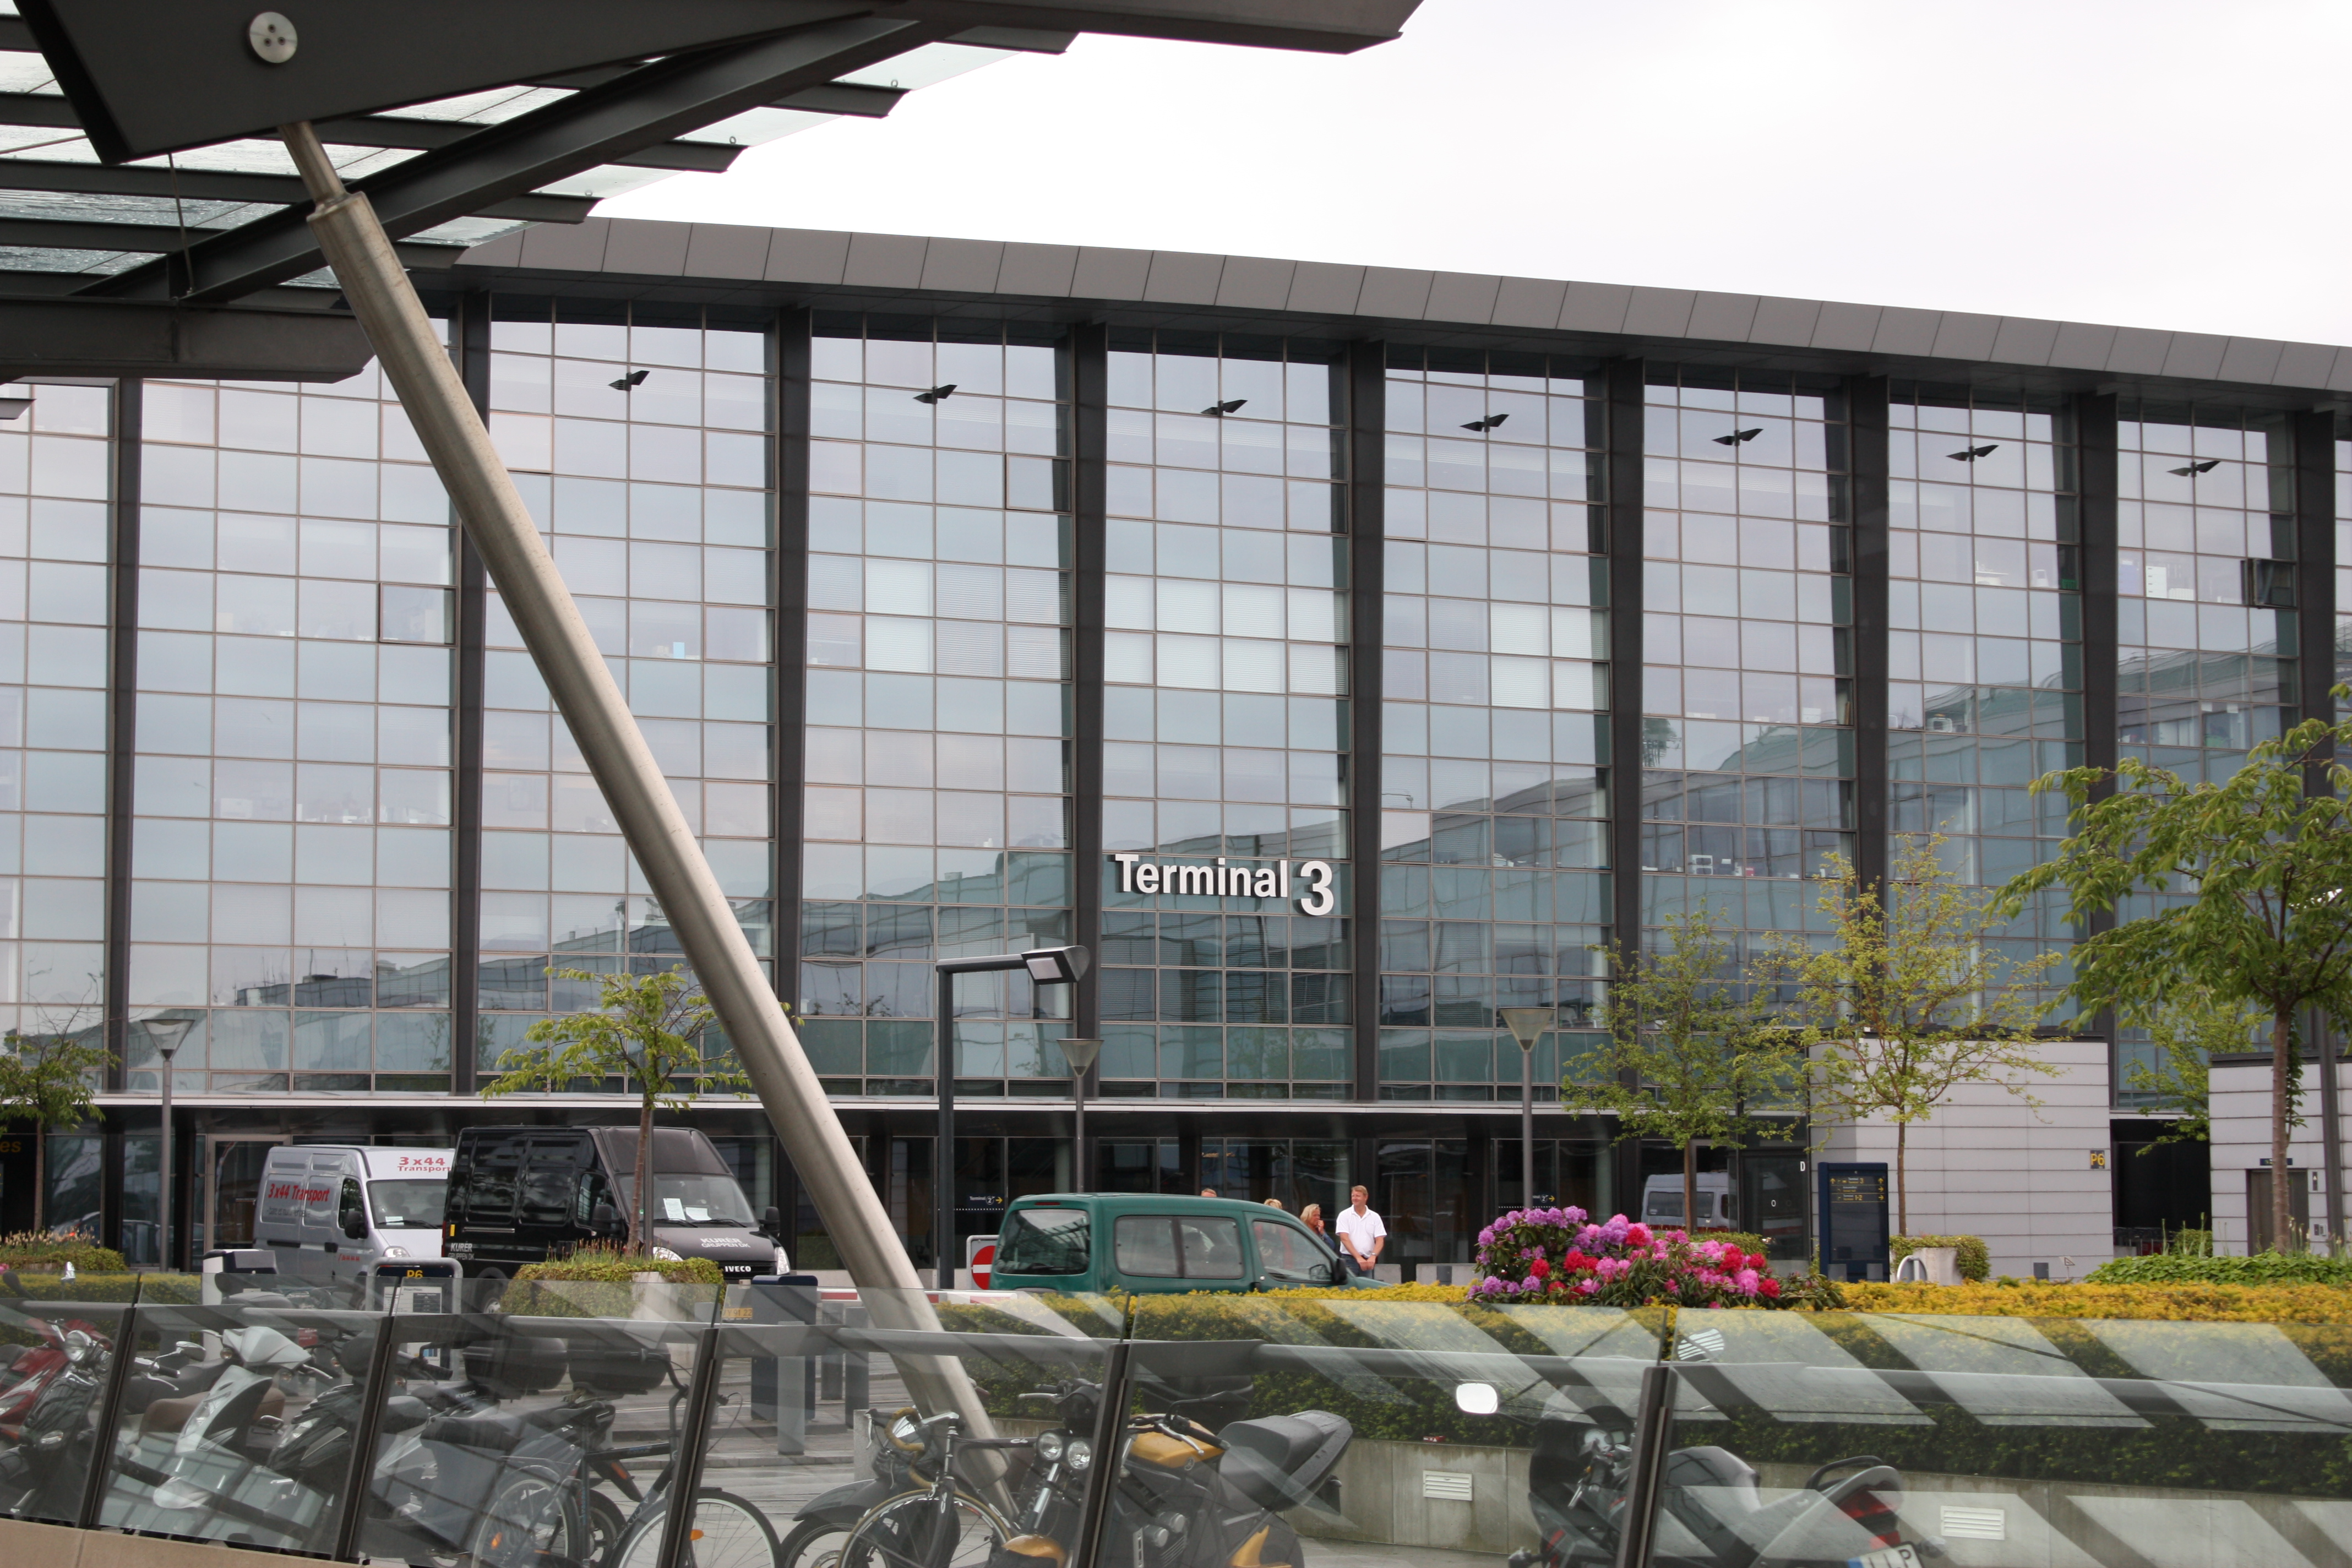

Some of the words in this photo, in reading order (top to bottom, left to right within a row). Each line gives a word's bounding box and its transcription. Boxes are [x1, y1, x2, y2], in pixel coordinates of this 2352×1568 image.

[1115, 854, 1288, 898] Terminal
[1300, 860, 1335, 917] 3
[399, 1157, 409, 1166] 3
[2090, 1153, 2105, 1166] P6
[1800, 1161, 1806, 1172] D
[268, 1184, 275, 1199] 3
[292, 1185, 330, 1206] Transport
[407, 1270, 423, 1279] P6
